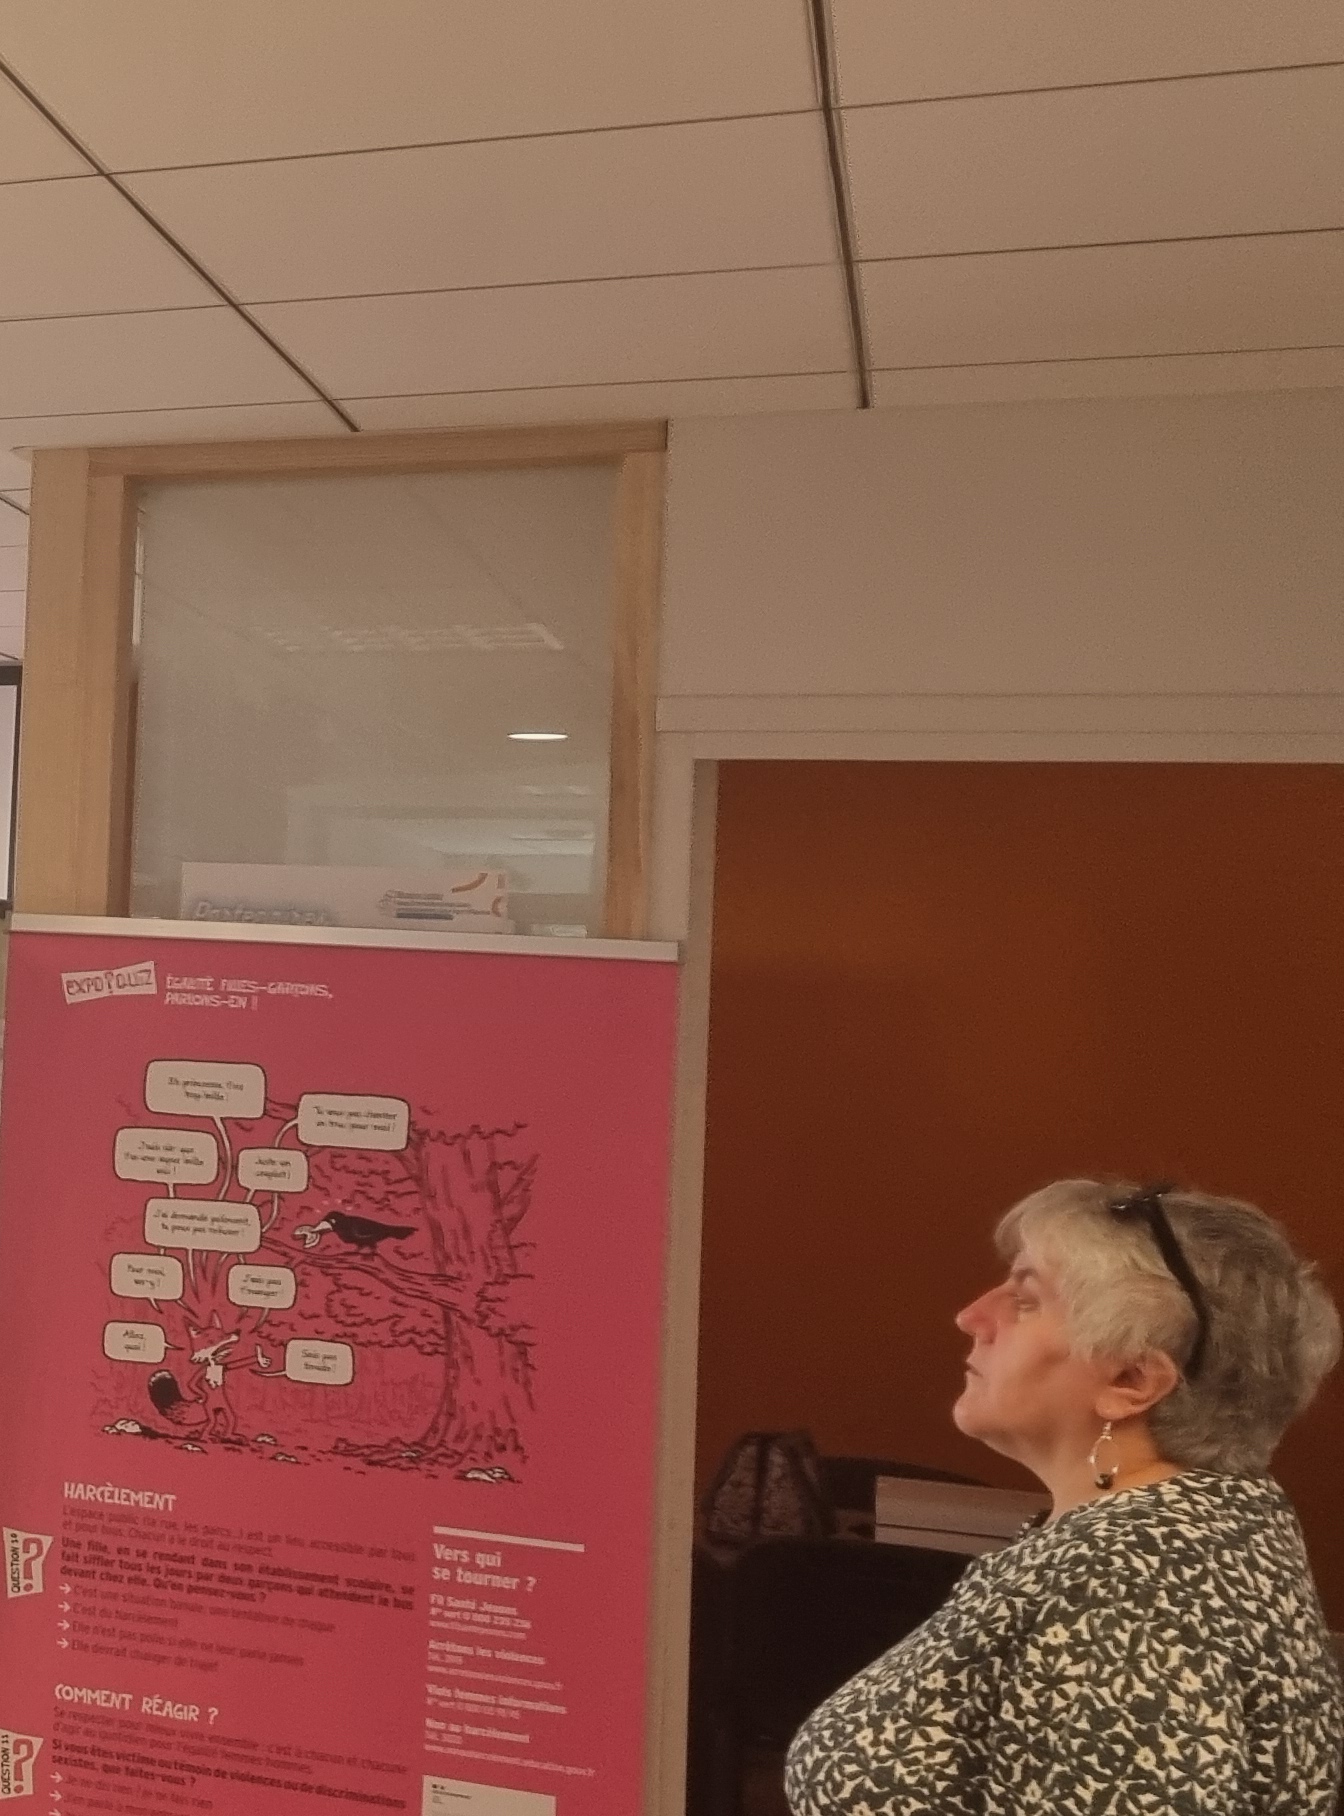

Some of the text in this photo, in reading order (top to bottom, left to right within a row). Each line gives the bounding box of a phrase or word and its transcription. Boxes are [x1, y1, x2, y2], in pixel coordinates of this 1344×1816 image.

[64, 1481, 177, 1512] HARCÈLEMENT
[11, 1547, 21, 1593] QUESTION
[433, 1543, 502, 1568] Vers qui
[432, 1566, 450, 1581] se
[456, 1567, 520, 1590] tourner
[54, 1683, 219, 1725] COMMENT RÉAGIR ?
[1, 1745, 11, 1795] QUESTION
